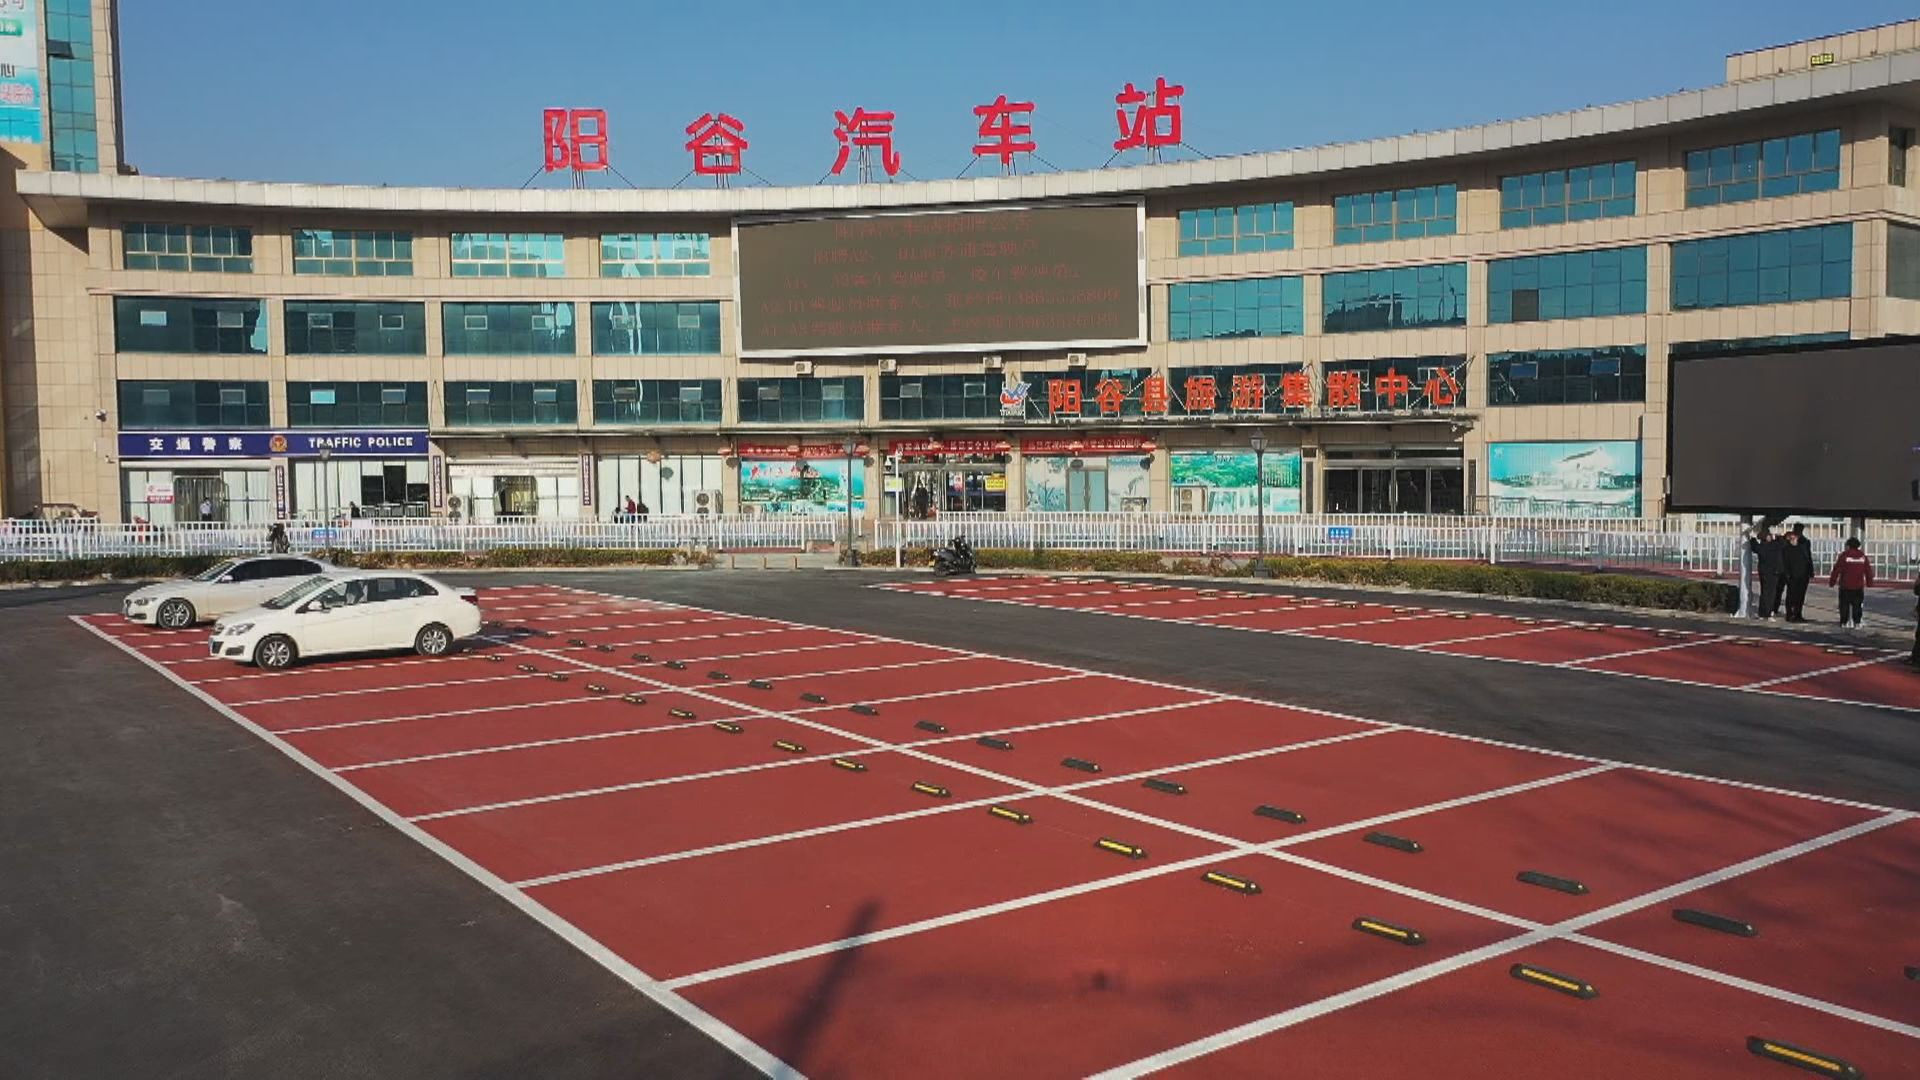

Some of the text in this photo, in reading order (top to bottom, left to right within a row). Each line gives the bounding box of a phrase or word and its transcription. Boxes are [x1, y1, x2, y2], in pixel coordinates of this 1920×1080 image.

[544, 77, 1184, 175] 阳谷汽车站
[1047, 367, 1460, 415] 阳谷县旅游集散中心
[149, 437, 243, 452] 交通警察
[308, 437, 413, 449] TRAFFIC POLICE
